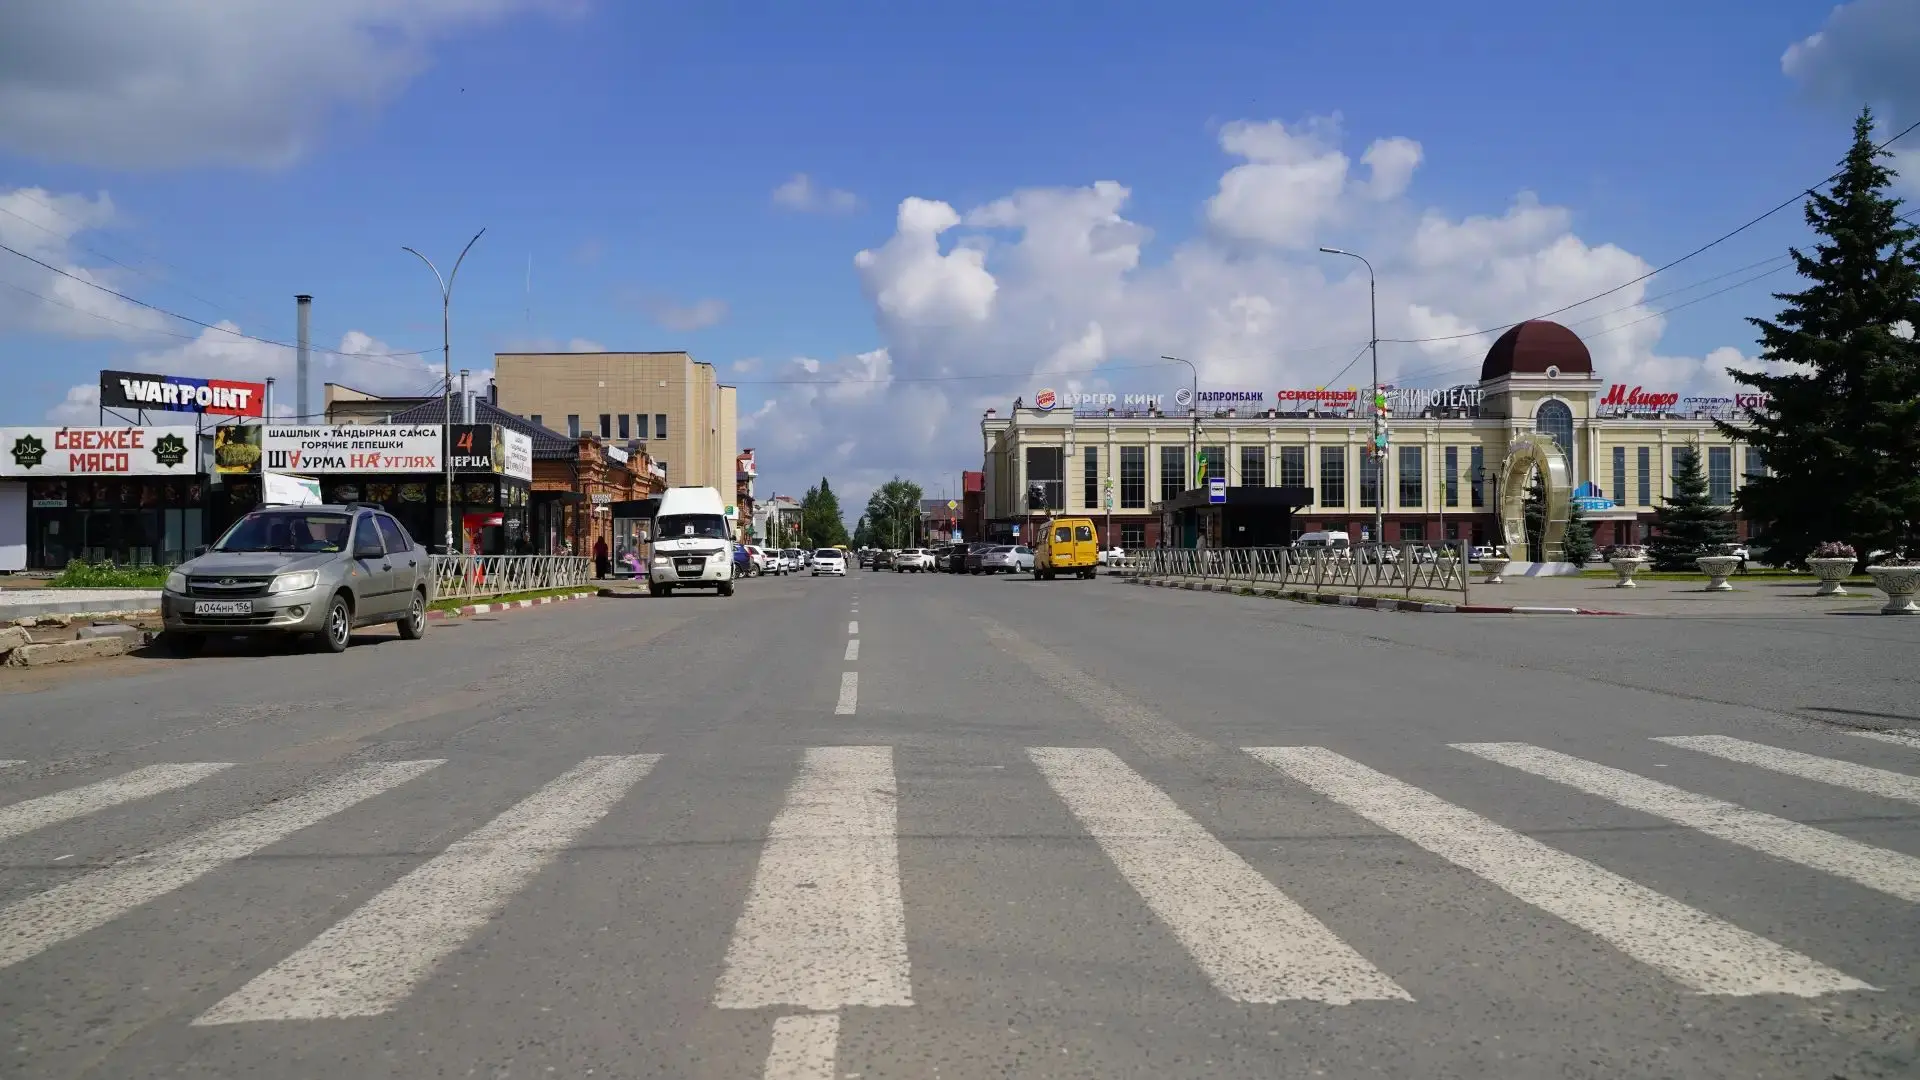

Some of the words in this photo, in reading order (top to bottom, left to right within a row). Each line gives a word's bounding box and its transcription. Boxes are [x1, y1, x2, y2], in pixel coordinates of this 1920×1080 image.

[120, 379, 253, 409] WARPOINT
[1063, 393, 1117, 405] БУРГЕР
[1124, 393, 1165, 405] КИНГ
[1197, 391, 1263, 401] ГАЗПРОМБАНК
[1401, 388, 1486, 407] КИНОТЕАТР
[55, 430, 144, 449] СВЕЖЕЕ
[268, 429, 320, 438] ШАШЛЫК
[332, 429, 396, 438] ТАНДЫРНАЯ
[399, 429, 437, 437] САМСА
[301, 441, 348, 449] ГОРЯЧИЕ
[351, 441, 403, 449] ЛЕПЕШКИ
[70, 453, 129, 472] МЯСО
[350, 452, 381, 468] НА
[384, 456, 435, 468] УГЛЯХ
[1083, 526, 1090, 536] 2
[235, 602, 249, 610] 156
